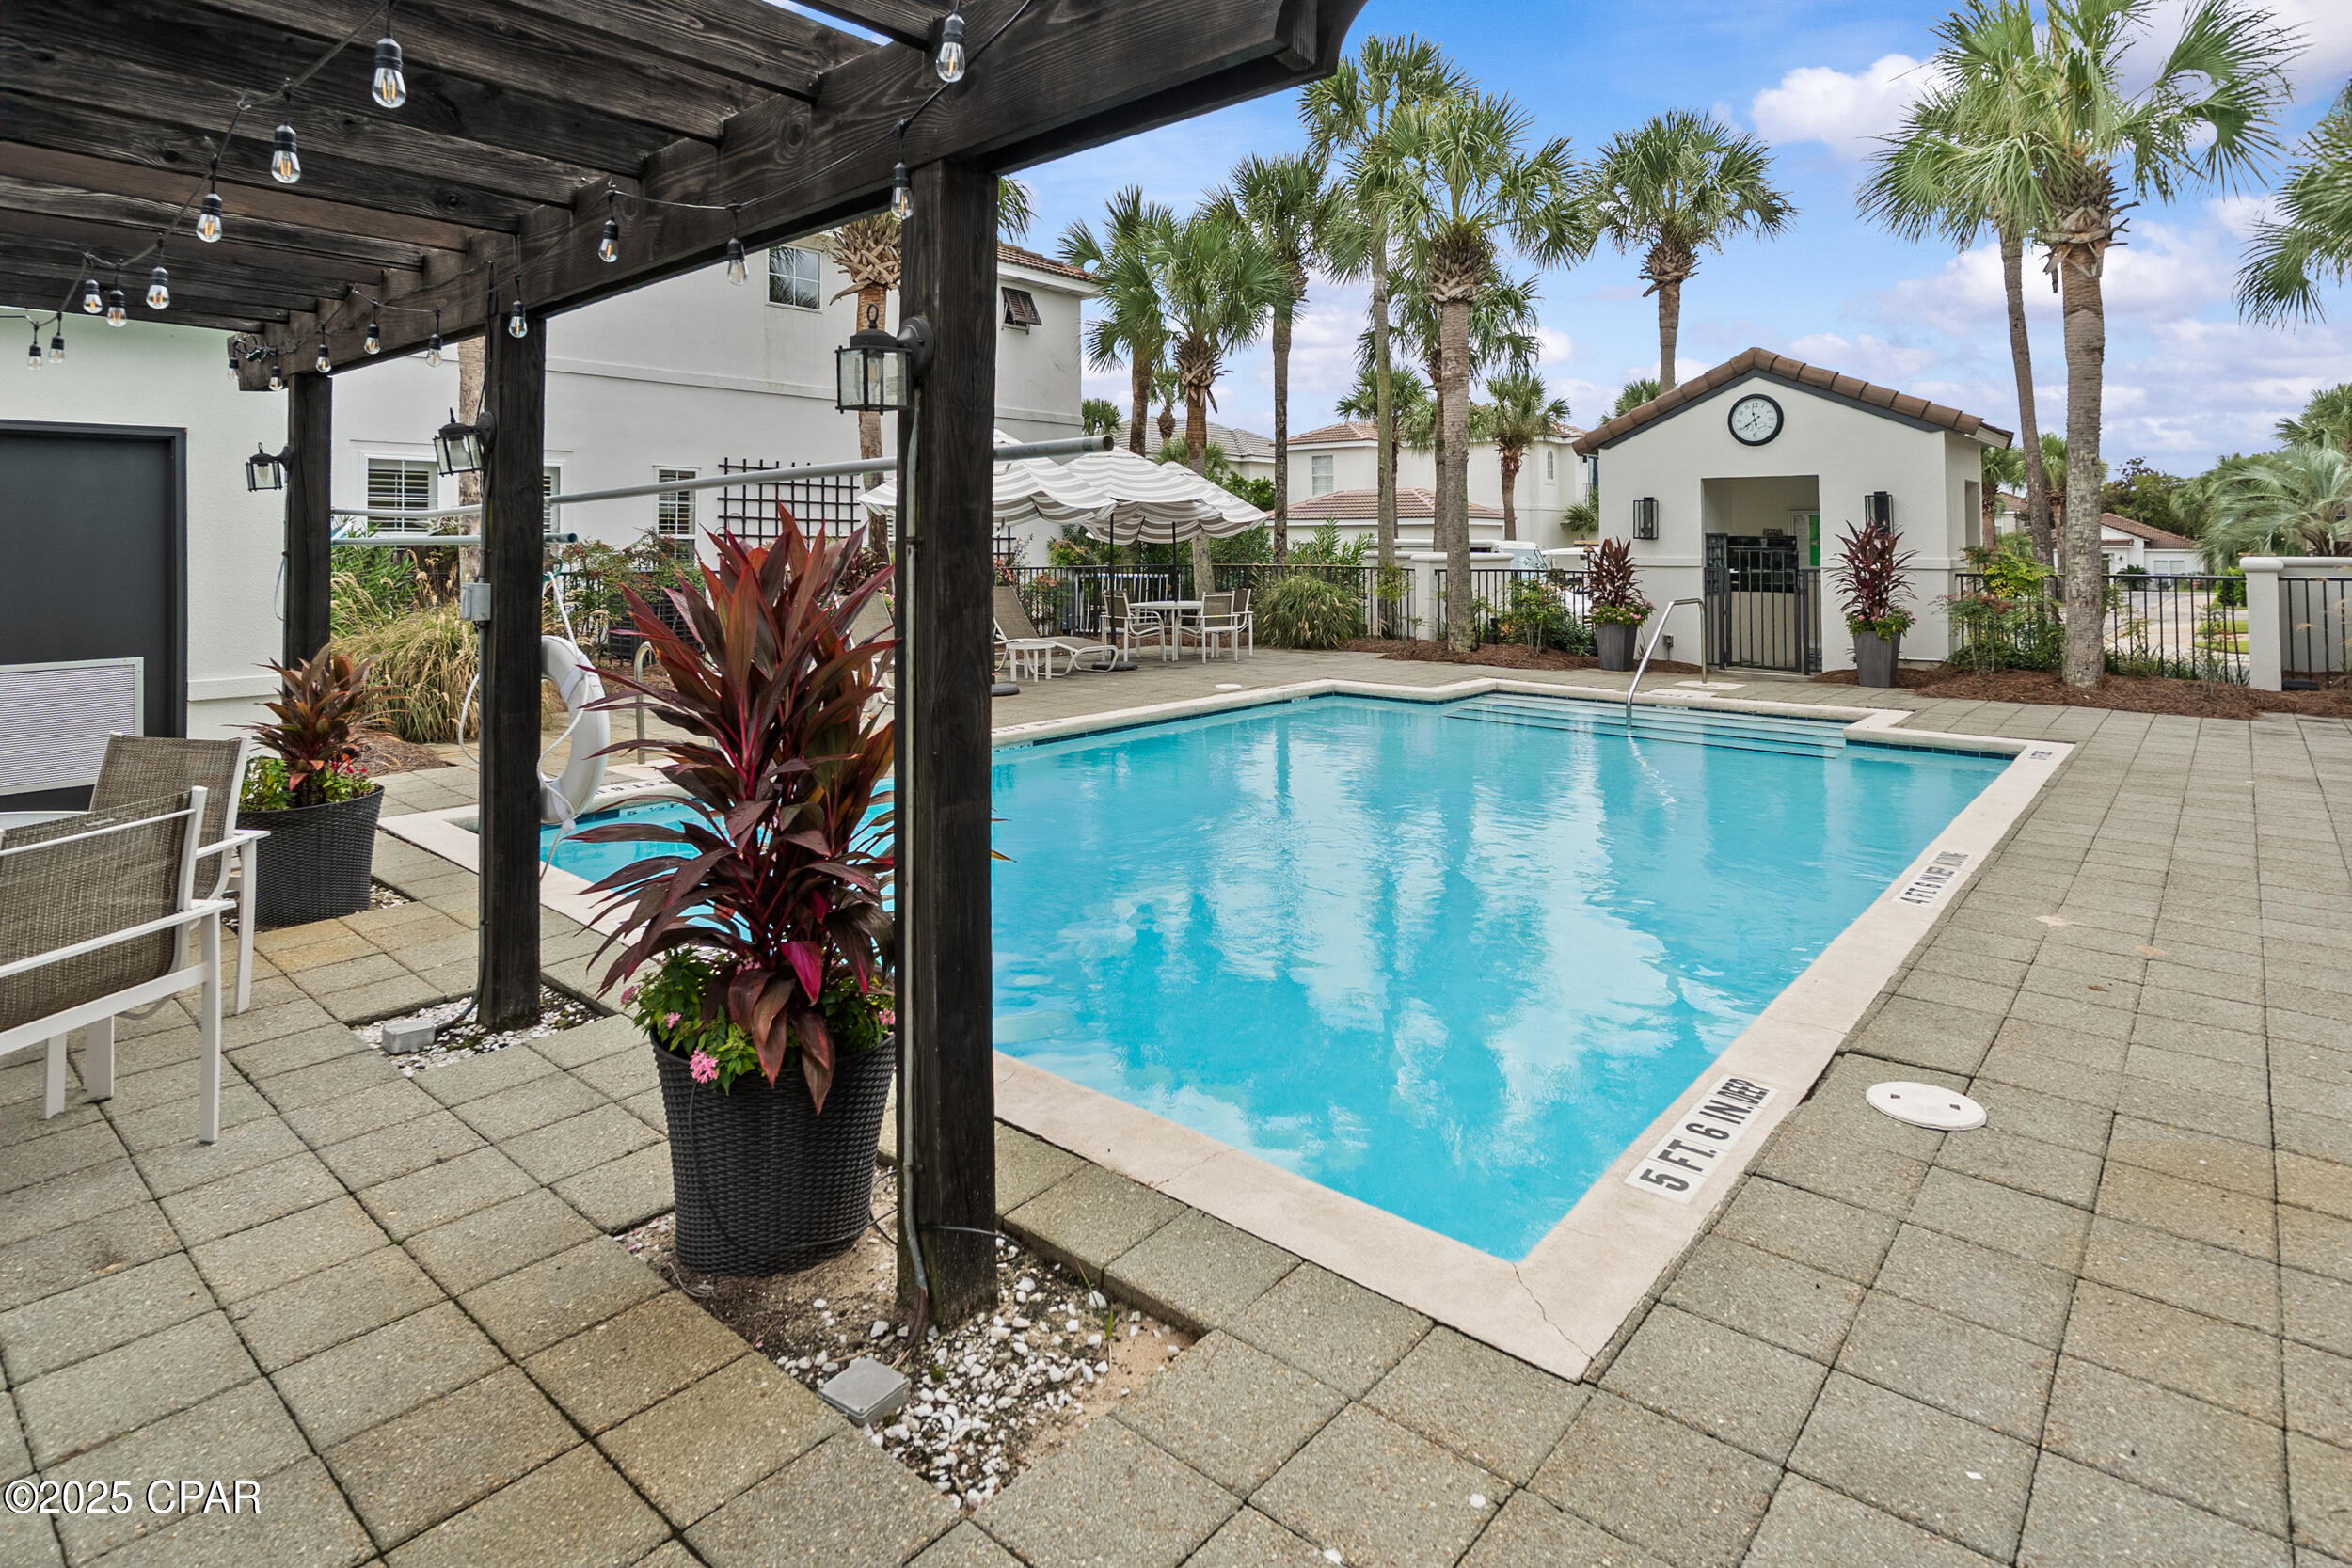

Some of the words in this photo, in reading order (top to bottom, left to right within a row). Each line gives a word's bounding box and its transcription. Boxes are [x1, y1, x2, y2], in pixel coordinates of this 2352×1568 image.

[1717, 1078, 1770, 1105] DEEP
[1699, 1100, 1754, 1125] IN.
[1686, 1122, 1730, 1140] 6
[1657, 1139, 1717, 1172] FT.
[1639, 1168, 1690, 1192] 5
